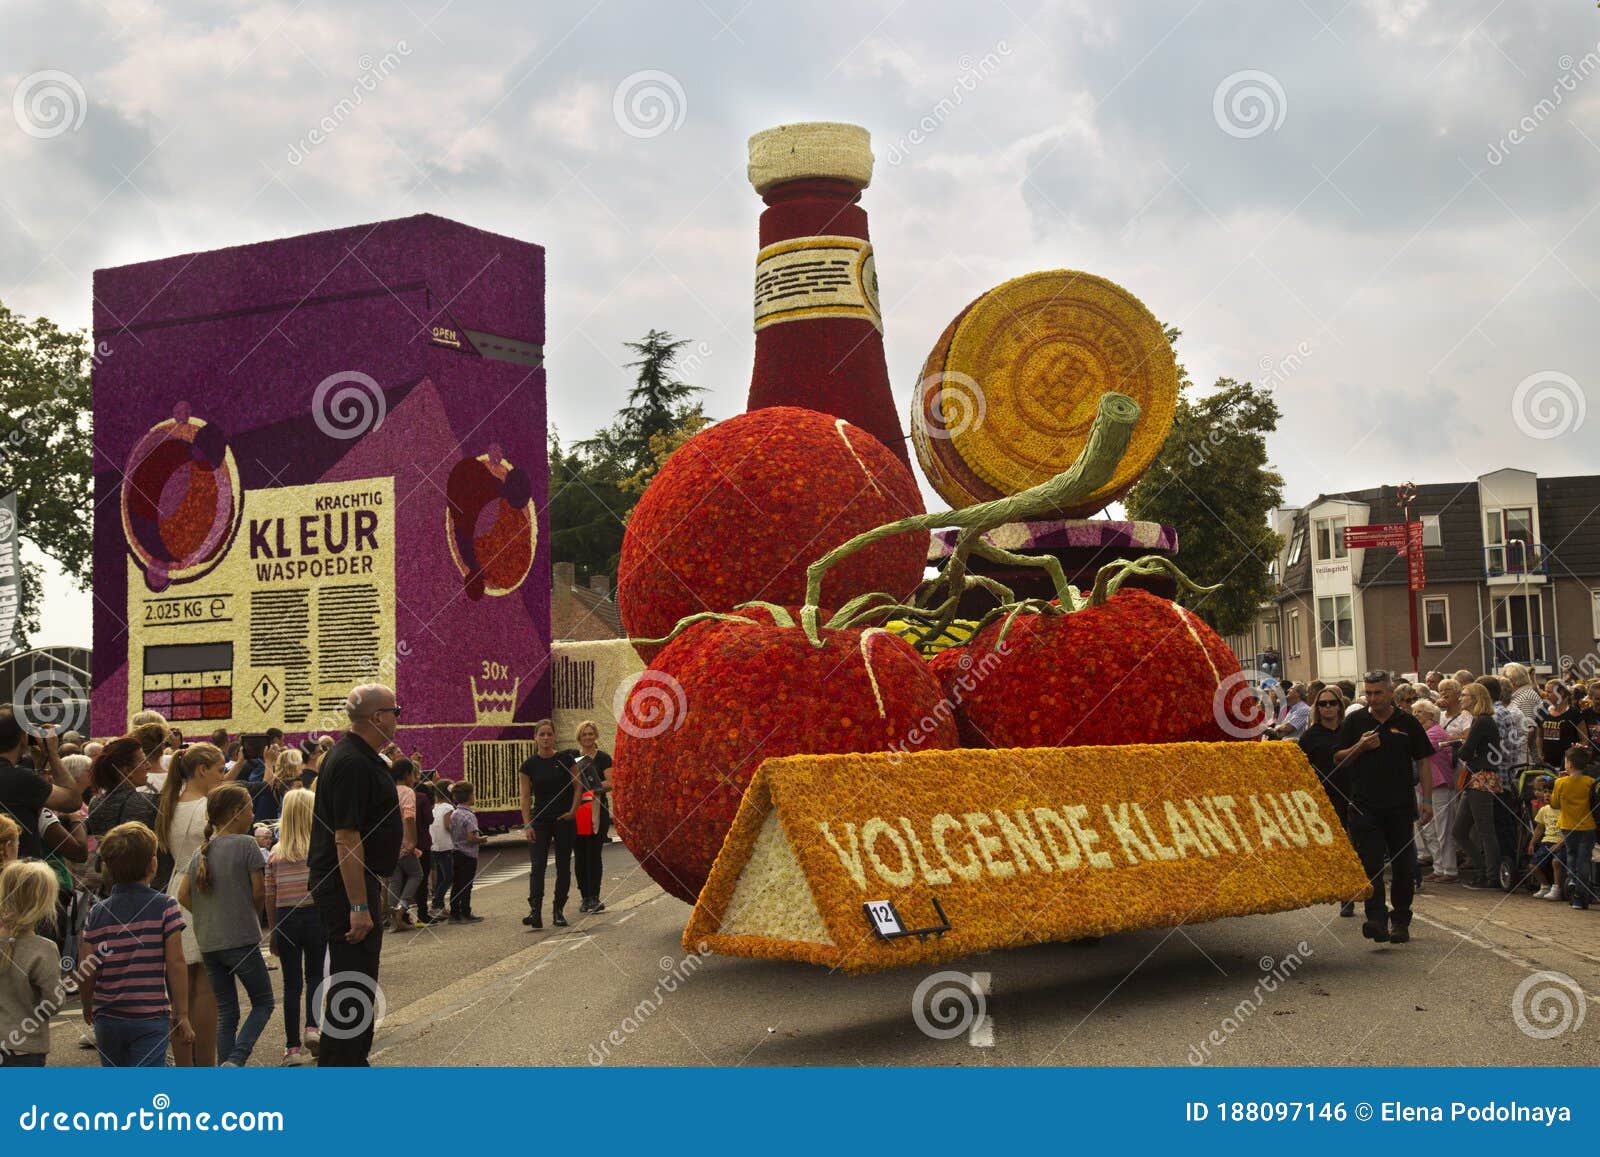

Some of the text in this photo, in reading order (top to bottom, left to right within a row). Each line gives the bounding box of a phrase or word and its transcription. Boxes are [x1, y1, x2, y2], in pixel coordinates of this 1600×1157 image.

[432, 327, 456, 340] OPEN
[315, 491, 382, 511] KRACHTIG
[250, 510, 380, 559] KLEUR
[256, 555, 373, 581] WASPOEDER
[145, 603, 180, 620] 2.025
[184, 601, 202, 618] KG
[481, 660, 508, 680] 30x
[1102, 795, 1254, 865] KLANT
[1249, 790, 1333, 850] AUB
[872, 906, 893, 923] 12
